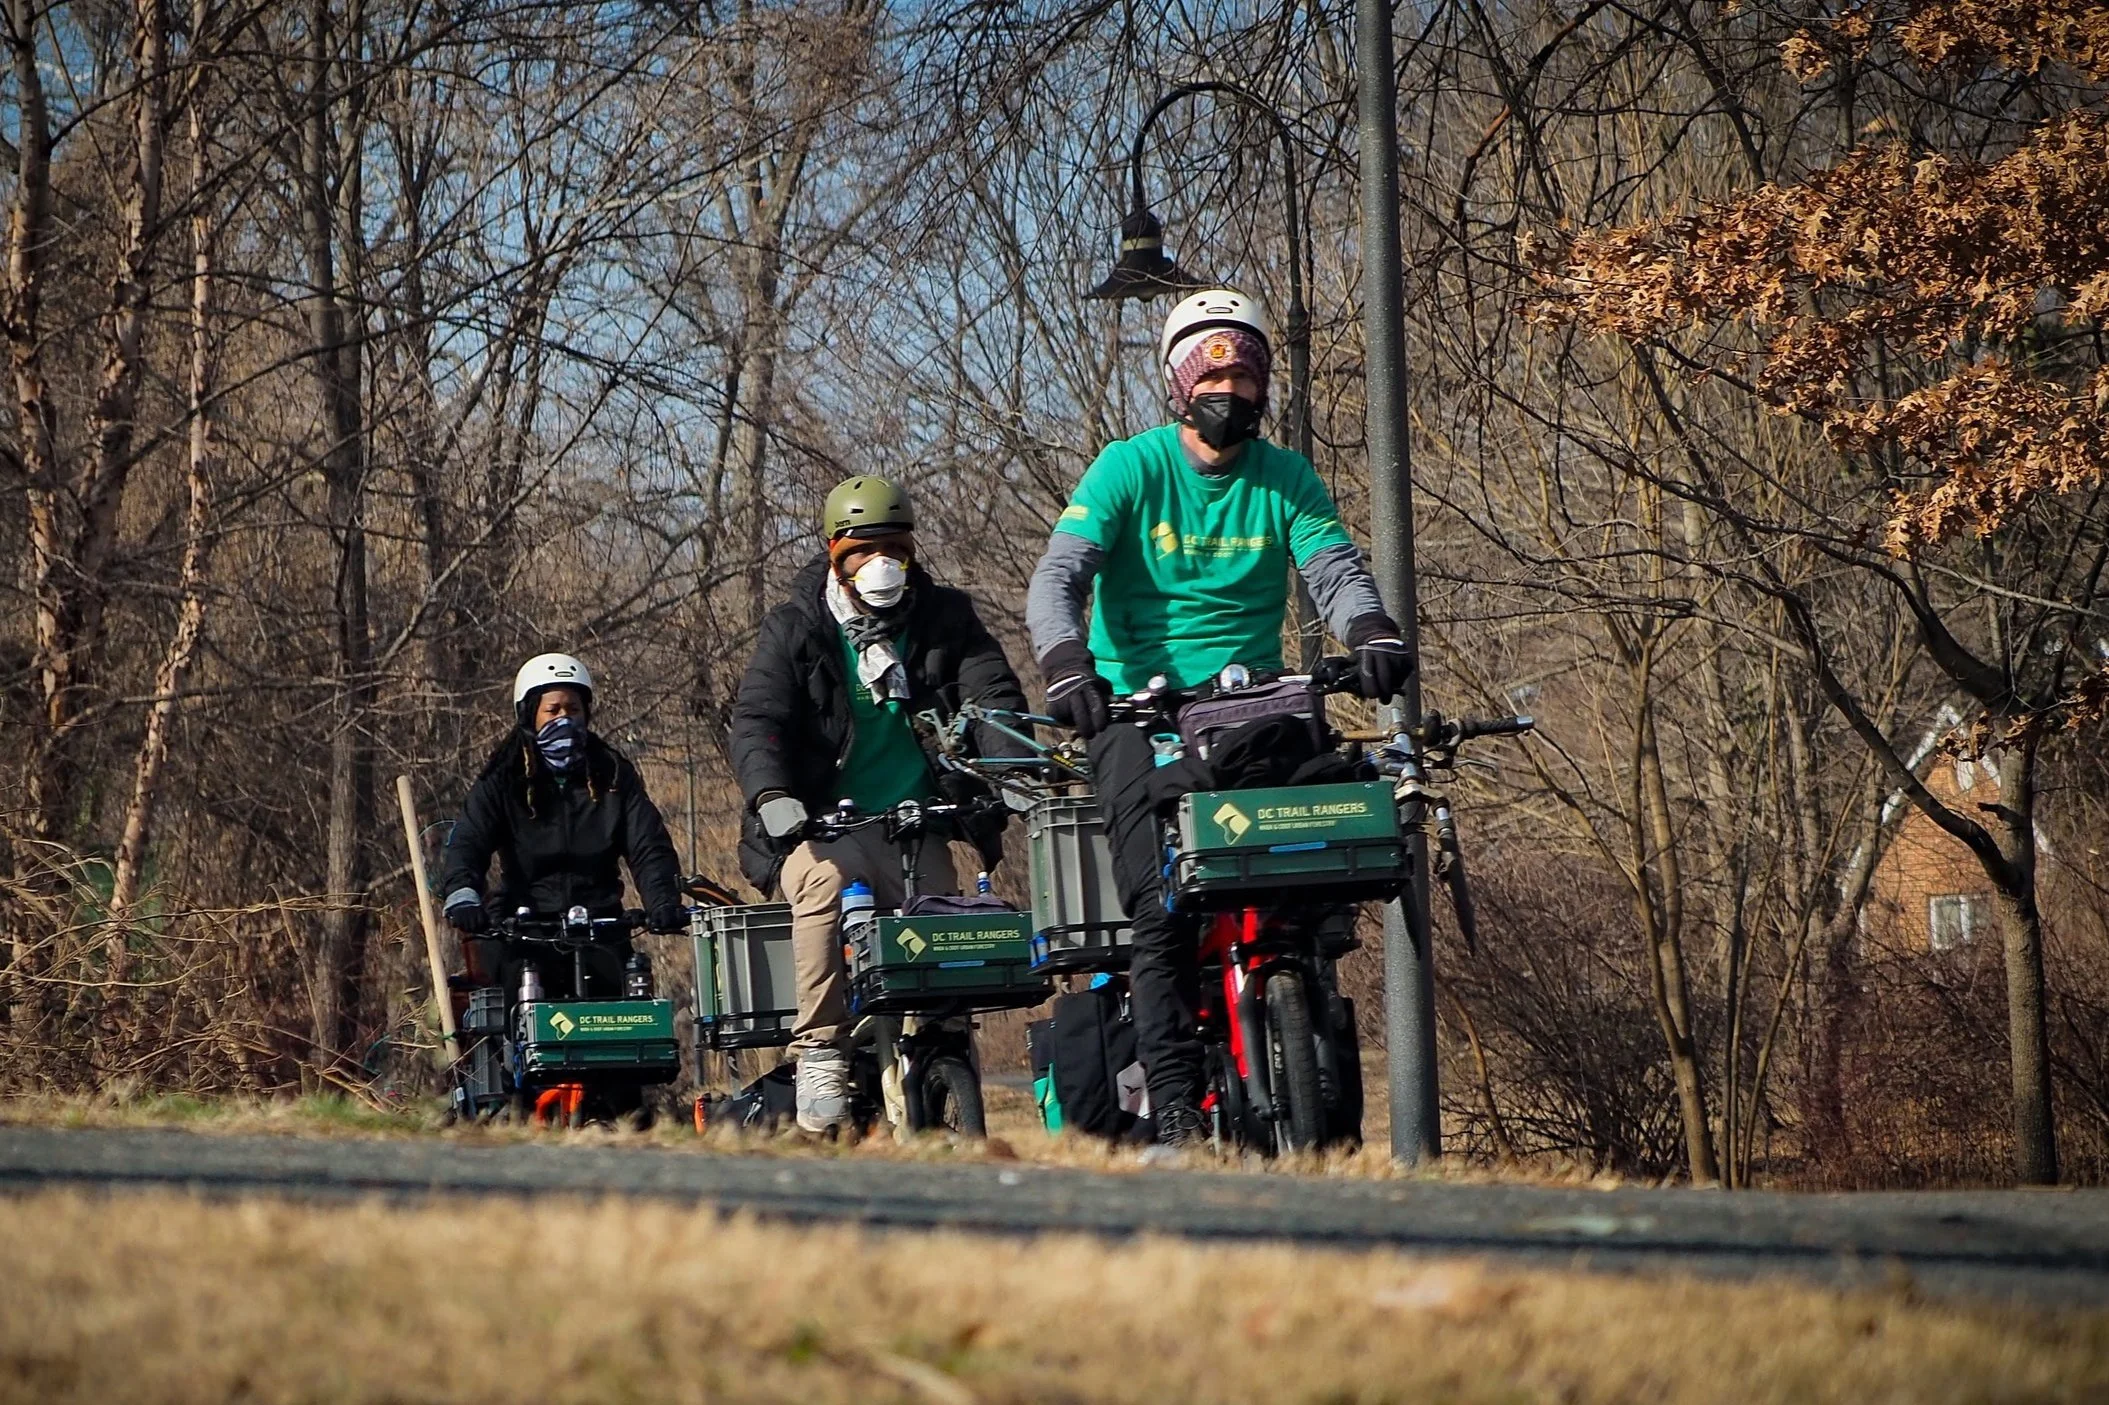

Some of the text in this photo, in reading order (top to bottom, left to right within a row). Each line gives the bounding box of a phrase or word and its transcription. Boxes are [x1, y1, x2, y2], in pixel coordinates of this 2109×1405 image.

[1257, 802, 1367, 819] DC TRAIL RANGERS
[932, 929, 1020, 942] DC TRAIL RANGERS
[579, 1015, 653, 1024] DC TRAIL RANGERS
